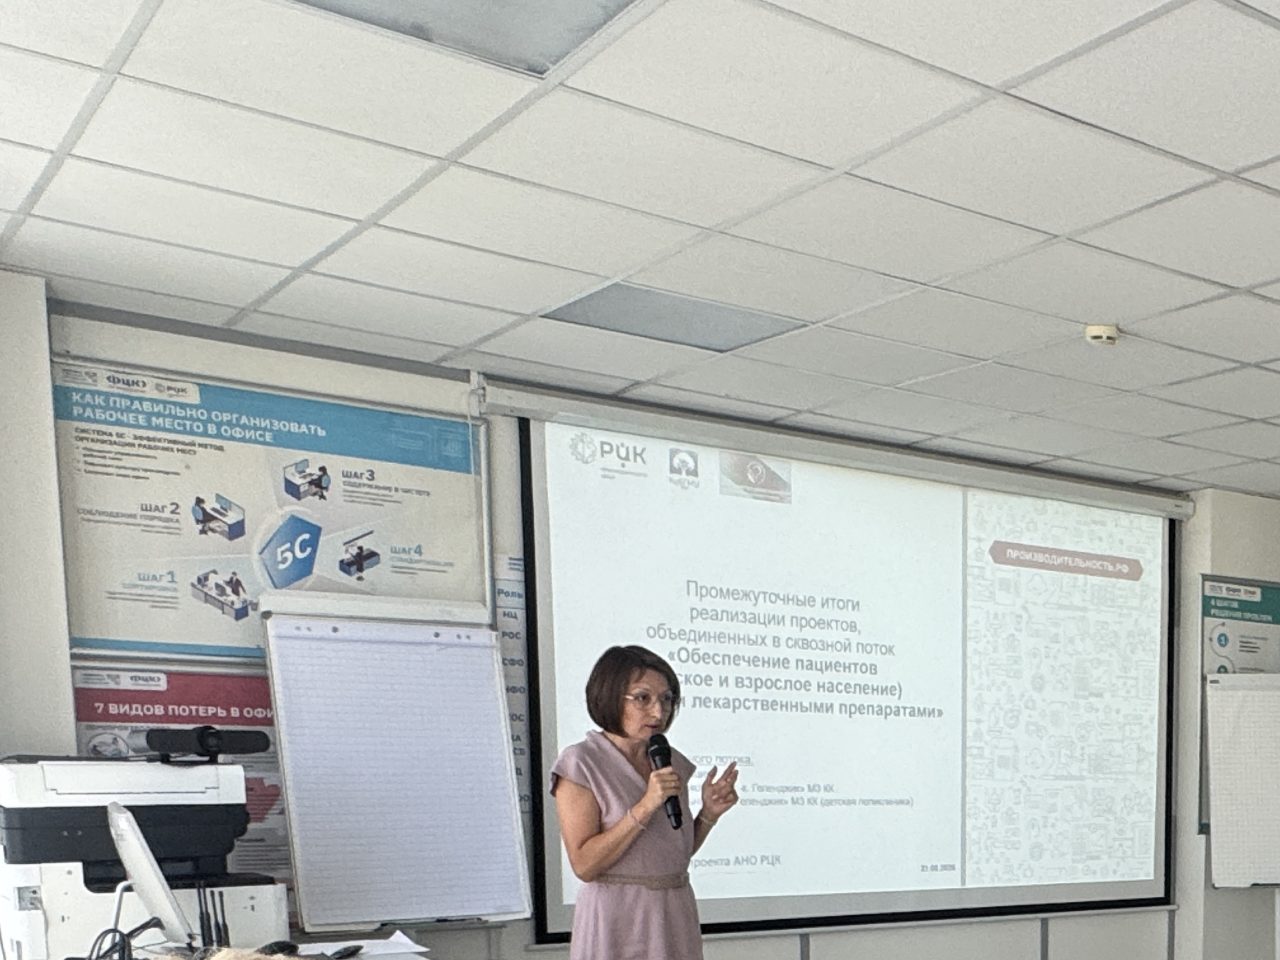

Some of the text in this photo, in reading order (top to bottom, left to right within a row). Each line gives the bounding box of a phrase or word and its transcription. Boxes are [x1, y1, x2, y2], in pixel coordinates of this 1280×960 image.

[72, 391, 326, 437] КАК ПРАВИЛЬНО ОРГАНИЗОВАТЬ
[72, 406, 273, 442] РАБОЧЕЕ МЕСТО В ОФИСЕ
[342, 469, 375, 482] ШАГ 3
[140, 501, 181, 515] ШАГ 2
[276, 533, 313, 570] 5С
[390, 544, 423, 557] ШАГ 4
[1006, 548, 1130, 574] ПРОИЗВОДИТЕЛЬНОСТЬ.РФ
[138, 571, 178, 583] ШАГ 1
[686, 580, 860, 612] Промежуточные итоги
[690, 606, 862, 635] реализации проектов,
[646, 623, 896, 656] объединенных в сквозной поток
[667, 646, 878, 675] «Обеспечение пациентов
[719, 675, 729, 688] и
[735, 676, 812, 696] взрослое
[816, 680, 903, 701] население)
[94, 703, 104, 713] 7
[109, 703, 165, 716] ВИДОВ
[167, 705, 227, 717] ПОТЕРЬ
[230, 706, 240, 718] В
[691, 695, 835, 714] лекарственными
[839, 702, 944, 720] препаратами»
